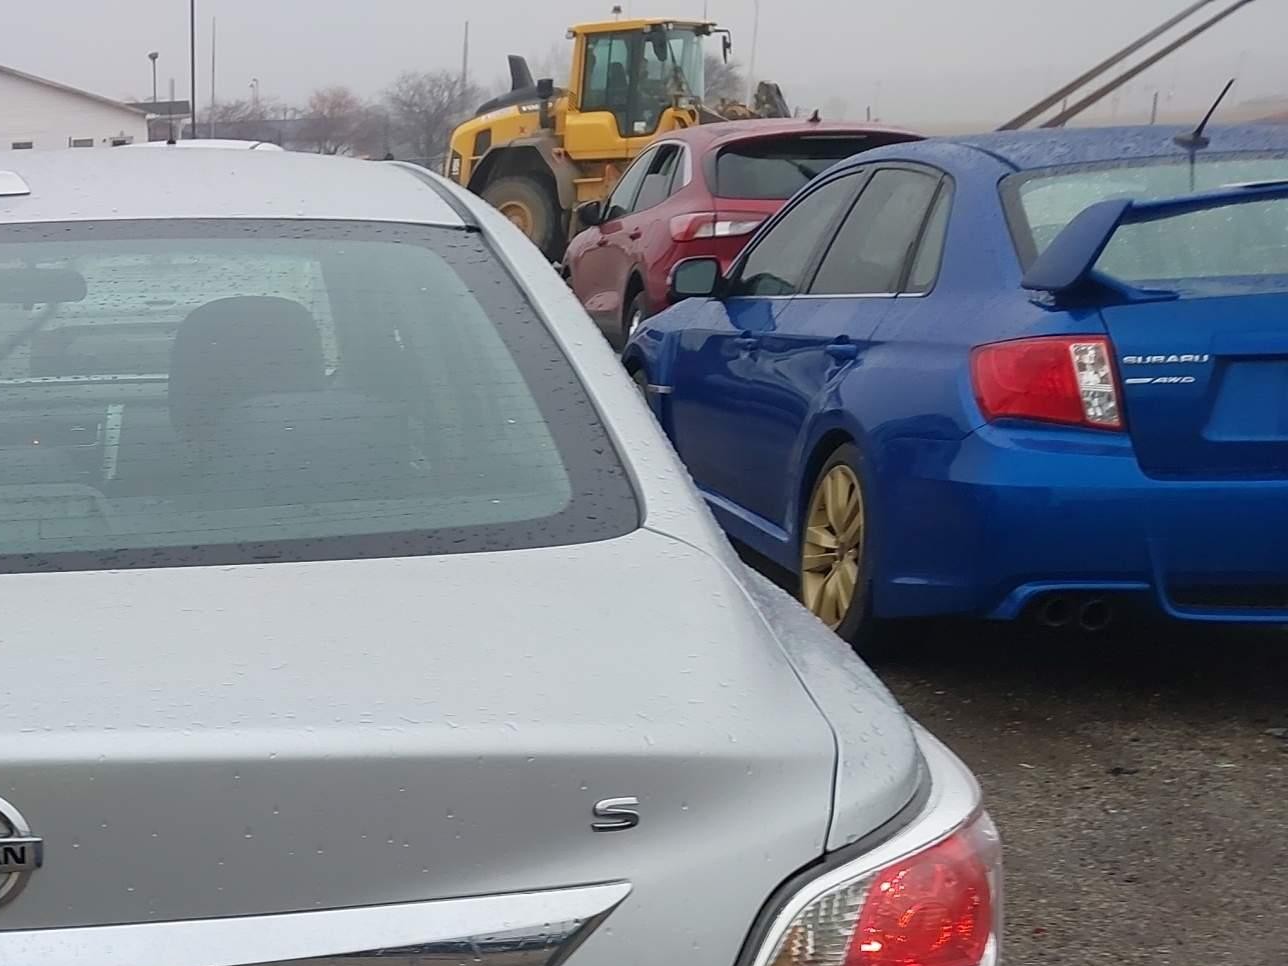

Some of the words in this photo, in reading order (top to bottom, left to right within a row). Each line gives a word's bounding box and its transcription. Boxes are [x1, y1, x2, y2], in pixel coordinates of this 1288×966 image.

[1122, 353, 1209, 364] SUBARU
[1151, 376, 1196, 384] AWD
[591, 796, 640, 833] S
